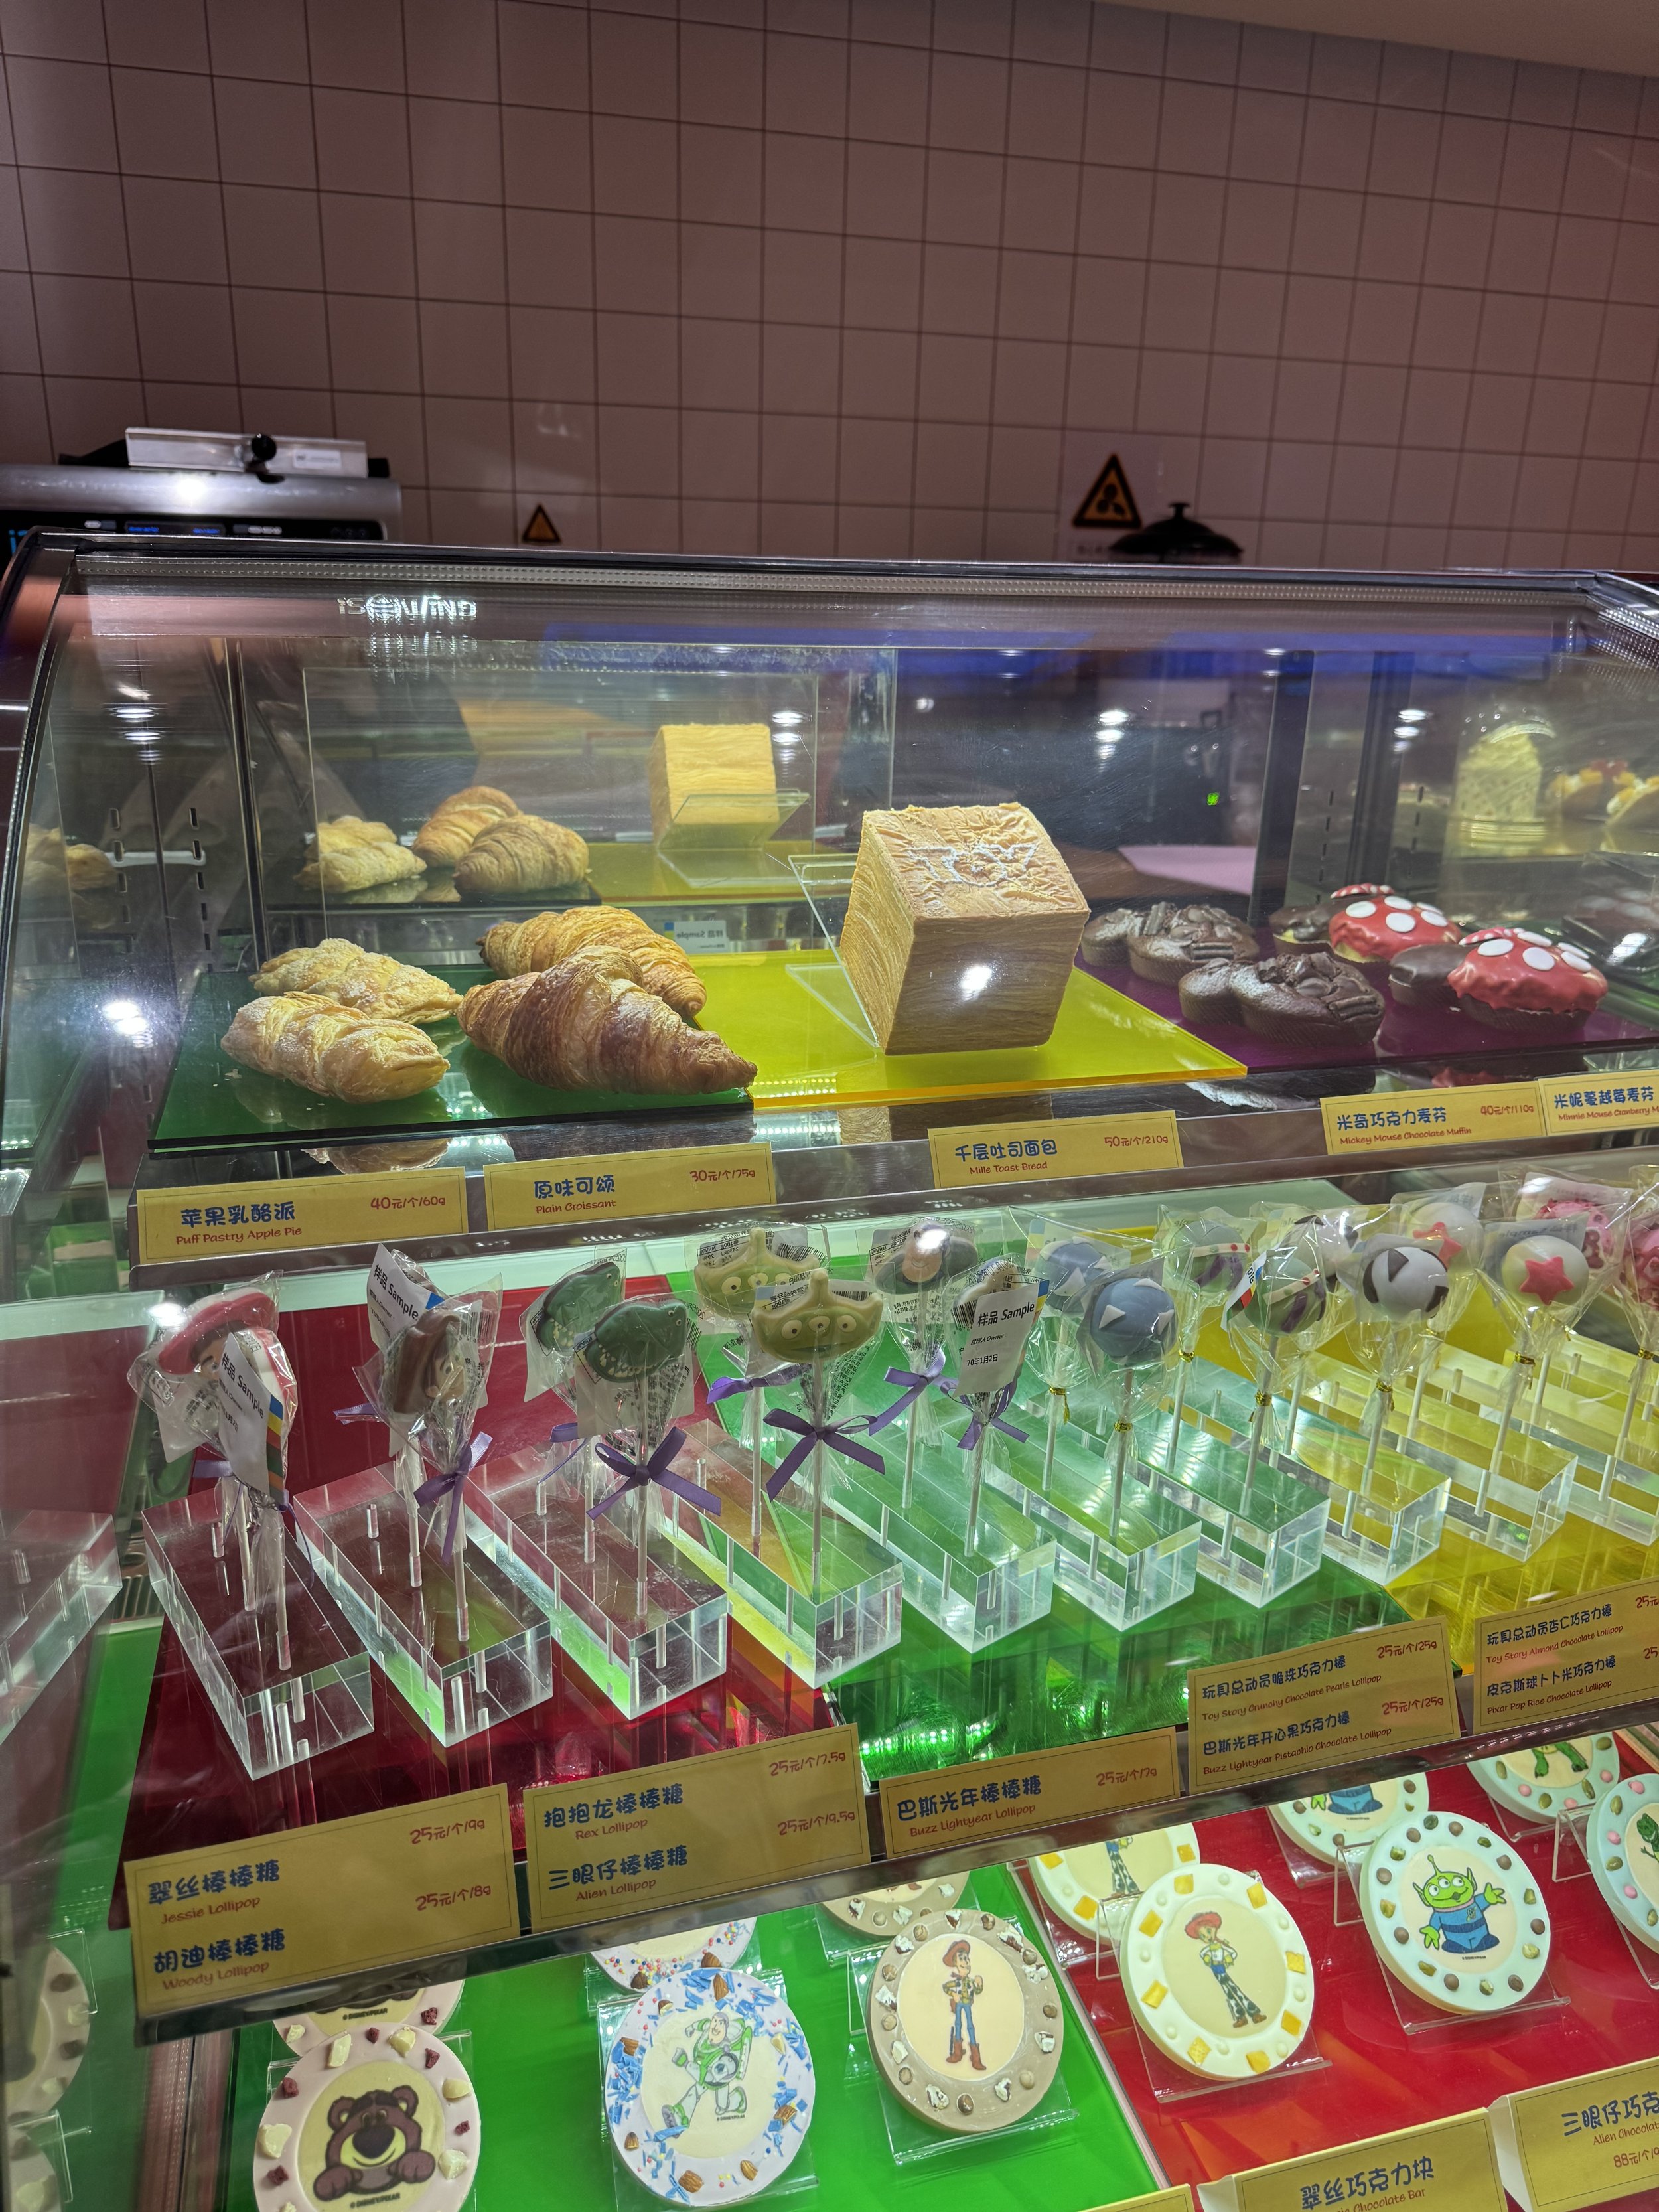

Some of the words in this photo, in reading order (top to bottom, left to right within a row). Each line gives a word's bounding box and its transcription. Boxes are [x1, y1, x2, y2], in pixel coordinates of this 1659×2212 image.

[1480, 1104, 1534, 1116] 40元/个/110g
[1554, 1086, 1654, 1110] 米妮蔓越莓麦芬
[1337, 1106, 1447, 1132] 米奇巧克力麦芬
[1558, 1111, 1585, 1121] Minnie
[1587, 1109, 1612, 1118] Mouse
[1614, 1106, 1650, 1116] Cranberry
[1104, 1134, 1169, 1147] 50元/个/210g
[1340, 1134, 1372, 1145] Mickey
[1374, 1132, 1402, 1142] Mouse
[1404, 1129, 1445, 1140] Chocolate
[1446, 1127, 1472, 1136] Muffin
[955, 1138, 1058, 1162] 千层吐司面包
[689, 1169, 756, 1183] 30元/个/75g
[970, 1165, 991, 1175] Mille
[993, 1164, 1020, 1173] Toast
[1022, 1161, 1048, 1170] Bread
[534, 1174, 616, 1199] 原味可颂
[180, 1201, 296, 1228] 苹果乳酪派
[370, 1195, 446, 1210] 40元/个/60g
[536, 1204, 562, 1214] Plain
[565, 1199, 616, 1212] Croissant
[176, 1234, 201, 1245] Puff
[202, 1230, 244, 1244] Pastry
[247, 1228, 281, 1240] Apple
[285, 1226, 303, 1236] Pie
[374, 1263, 388, 1290] 样品
[388, 1283, 419, 1319] Sample
[977, 1310, 999, 1327] 样品
[1001, 1301, 1035, 1321] Sample
[967, 1354, 999, 1366] 70年1月2日
[221, 1351, 236, 1382] 样品
[237, 1374, 264, 1419] Sample
[1487, 1603, 1613, 1646] 玩具总动员杏仁巧克力棒
[1377, 1640, 1437, 1659] 25元/个/25g
[1486, 1655, 1503, 1664] Toy
[1504, 1650, 1528, 1661] Story
[1528, 1642, 1559, 1655] Almond
[1561, 1633, 1595, 1648] Chocolate
[1597, 1625, 1624, 1637] Lollipop
[1202, 1655, 1346, 1700] 玩具总动员脆珠巧克力棒
[1487, 1655, 1616, 1697] 皮克斯球卜卜米巧克力棒
[1202, 1712, 1220, 1722] Toy
[1222, 1706, 1247, 1719] Story
[1248, 1698, 1283, 1713] Crunchy
[1285, 1687, 1325, 1704] Chocolate
[1326, 1682, 1350, 1694] Pearls
[1351, 1674, 1382, 1688] Lollipop
[1382, 1696, 1444, 1716] 25元/个/25g
[1486, 1704, 1508, 1714] Pixar
[1510, 1701, 1526, 1711] Pop
[1527, 1698, 1545, 1706] Rice
[1546, 1687, 1584, 1702] Chocolate
[1585, 1679, 1613, 1692] Lollipop
[1203, 1710, 1350, 1757] 巴斯光年开心果巧克力棒
[1203, 1765, 1227, 1775] Buzz
[1229, 1755, 1273, 1772] Lightyear
[1275, 1745, 1314, 1761] Pistachio
[1315, 1734, 1358, 1751] Chocolate
[1360, 1726, 1392, 1741] Lollipop
[769, 1751, 847, 1777] 25元/个/7.5g
[1096, 1767, 1158, 1787] 25元/个/7g
[544, 1783, 684, 1829] 抱抱龙棒棒糖
[897, 1774, 1043, 1822] 巴斯光年棒棒糖
[409, 1818, 486, 1845] 25元/个/9g
[575, 1828, 599, 1840] Rex
[601, 1817, 648, 1835] Lollipop
[778, 1810, 856, 1836] 25元/个/9.5g
[910, 1824, 938, 1838] Buzz
[940, 1812, 993, 1832] Lightyear
[995, 1803, 1037, 1820] Lollipop
[549, 1844, 688, 1891] 三眼仔棒棒糖
[148, 1859, 281, 1905] 翠丝棒棒糖
[575, 1888, 607, 1902] Alien
[609, 1878, 656, 1897] Lollipop
[161, 1907, 204, 1925] Jessie
[208, 1896, 261, 1915] Lollipop
[415, 1885, 492, 1911] 25元/个/8g
[153, 1927, 286, 1974] 胡迪棒棒糖
[162, 1970, 213, 1991] Woody
[216, 1960, 270, 1980] Lollipop
[1593, 2132, 1617, 2146] Alien
[1300, 2155, 1435, 2210] 翠丝巧克力块
[1353, 2193, 1406, 2212] Chocolate
[1407, 2188, 1426, 2199] Bar
